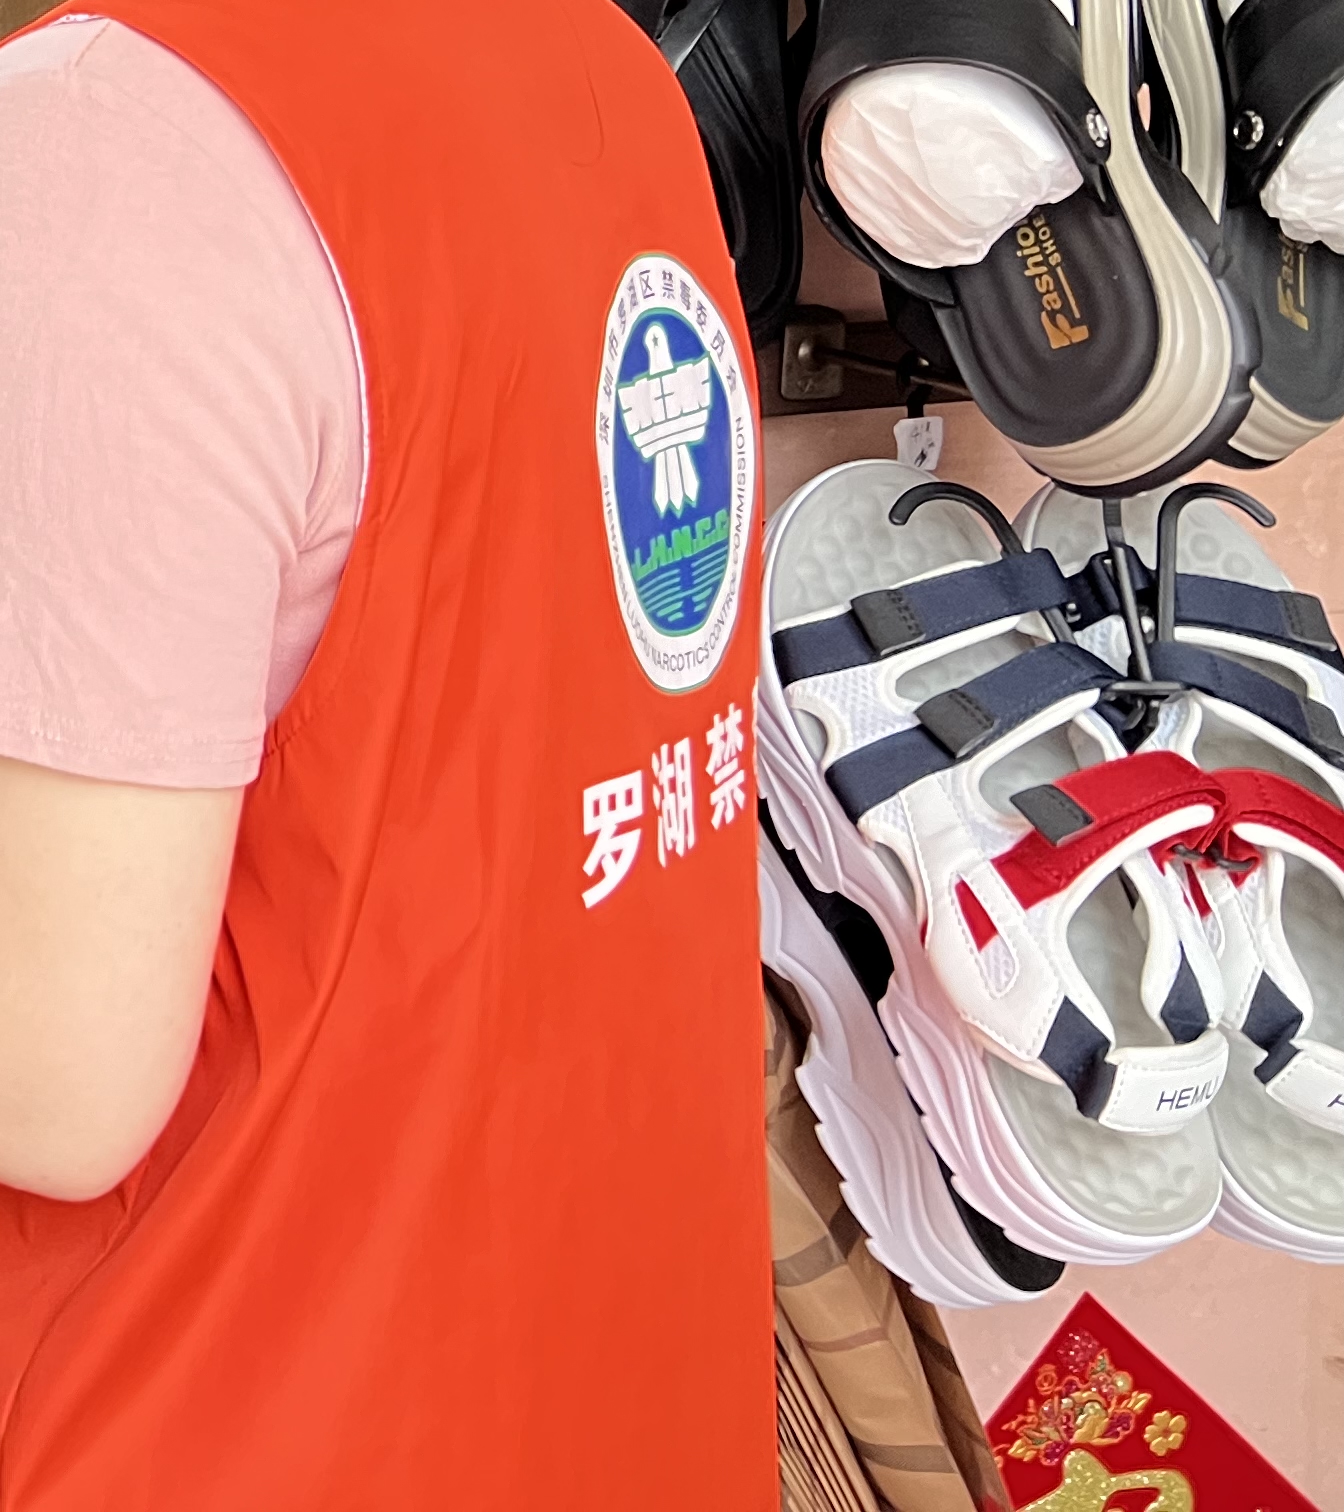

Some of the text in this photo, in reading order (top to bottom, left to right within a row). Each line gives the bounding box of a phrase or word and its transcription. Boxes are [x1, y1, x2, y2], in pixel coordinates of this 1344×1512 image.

[1015, 221, 1091, 350] Fashio
[650, 642, 710, 672] NARCOTICS
[732, 416, 748, 565] COMMISSION
[581, 688, 758, 910] 罗湖禁
